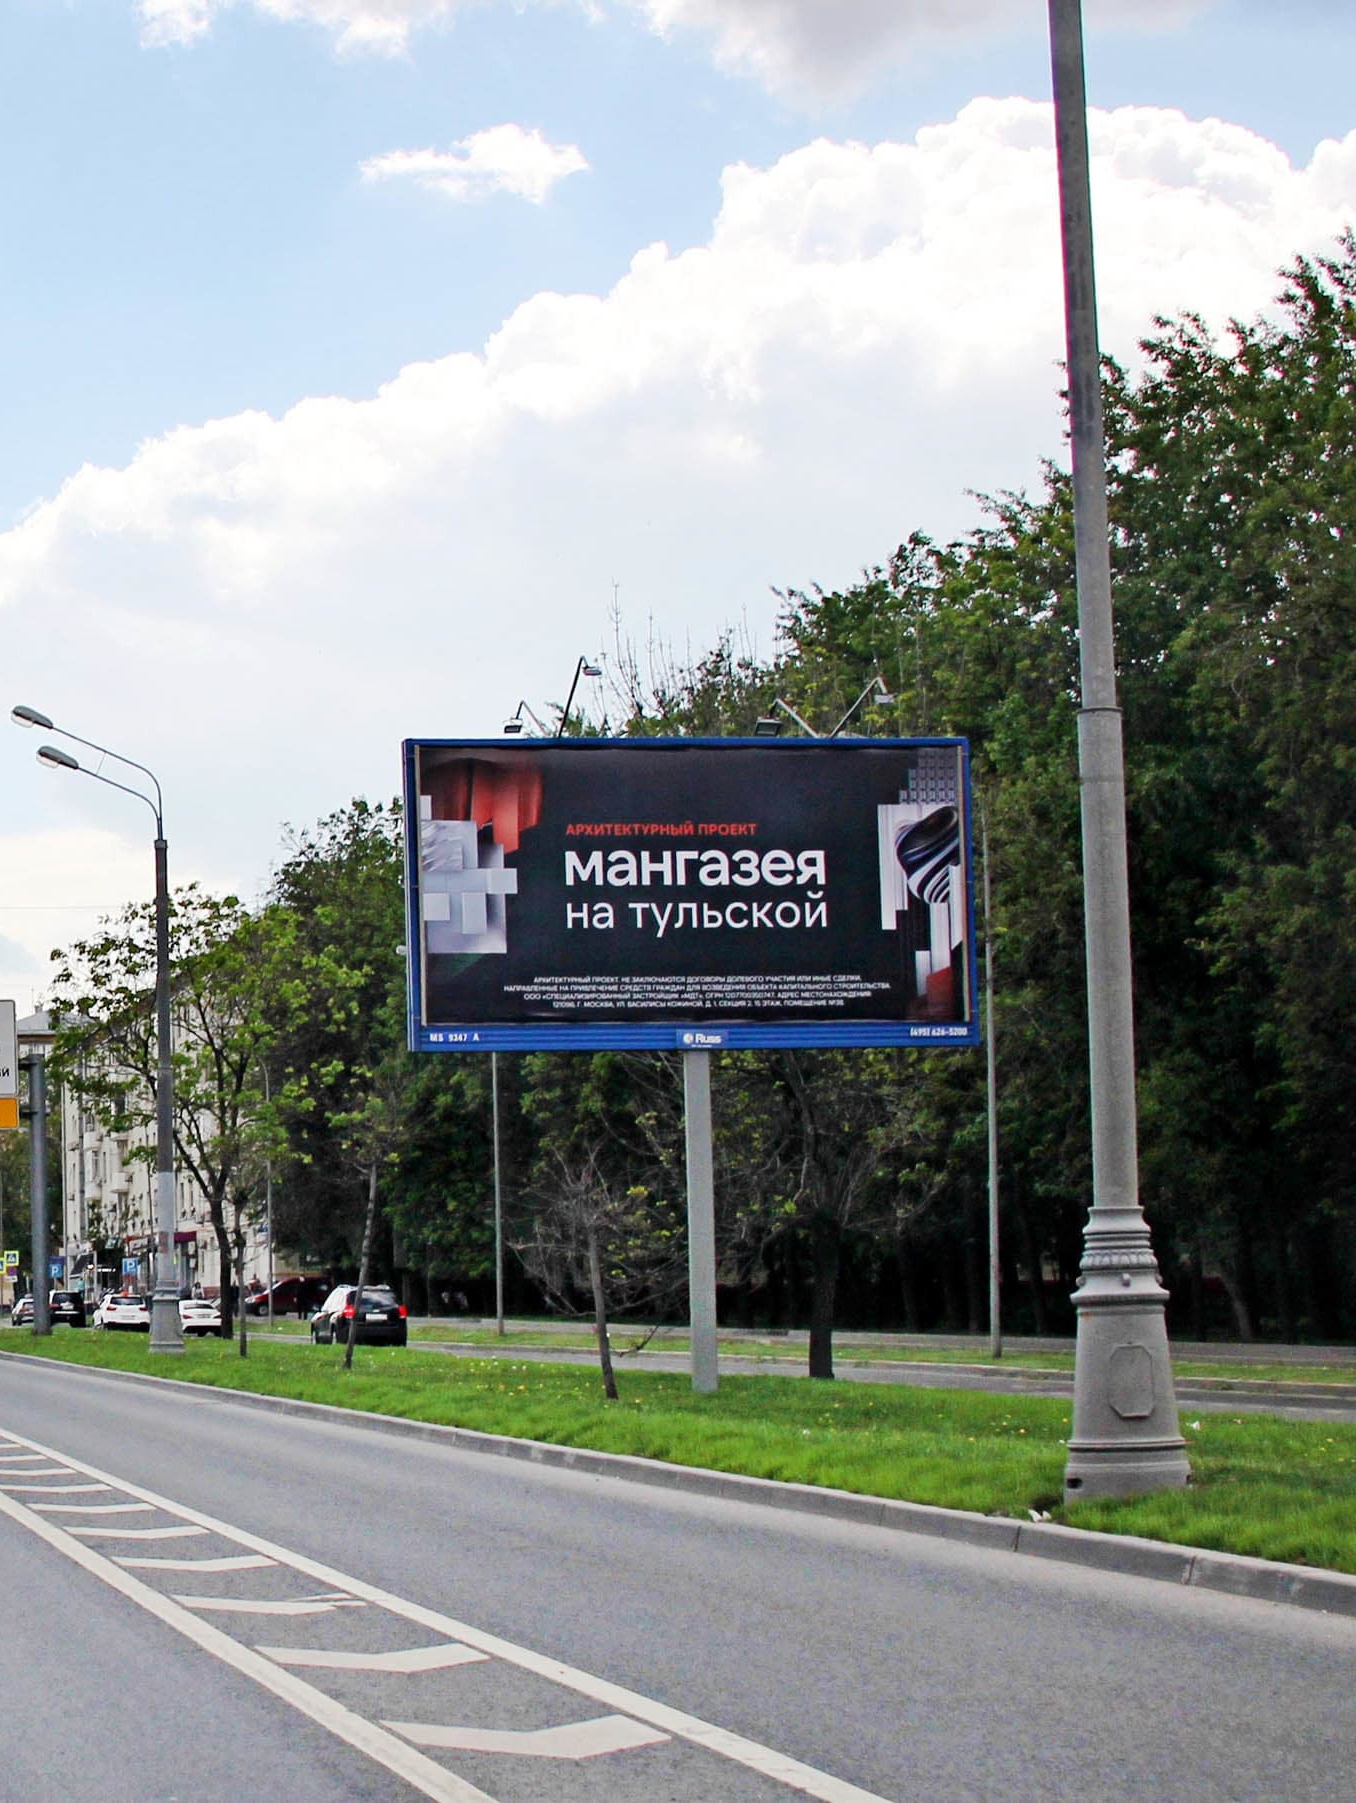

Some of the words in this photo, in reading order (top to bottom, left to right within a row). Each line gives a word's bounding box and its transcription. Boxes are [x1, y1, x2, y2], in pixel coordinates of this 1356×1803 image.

[565, 820, 694, 836] АРХИТЕКТУРНЫЙ
[698, 823, 757, 836] ПРОЕКТ
[564, 849, 826, 887] мангазея
[566, 902, 614, 929] на
[628, 890, 828, 938] тульской
[695, 1033, 722, 1044] Russ
